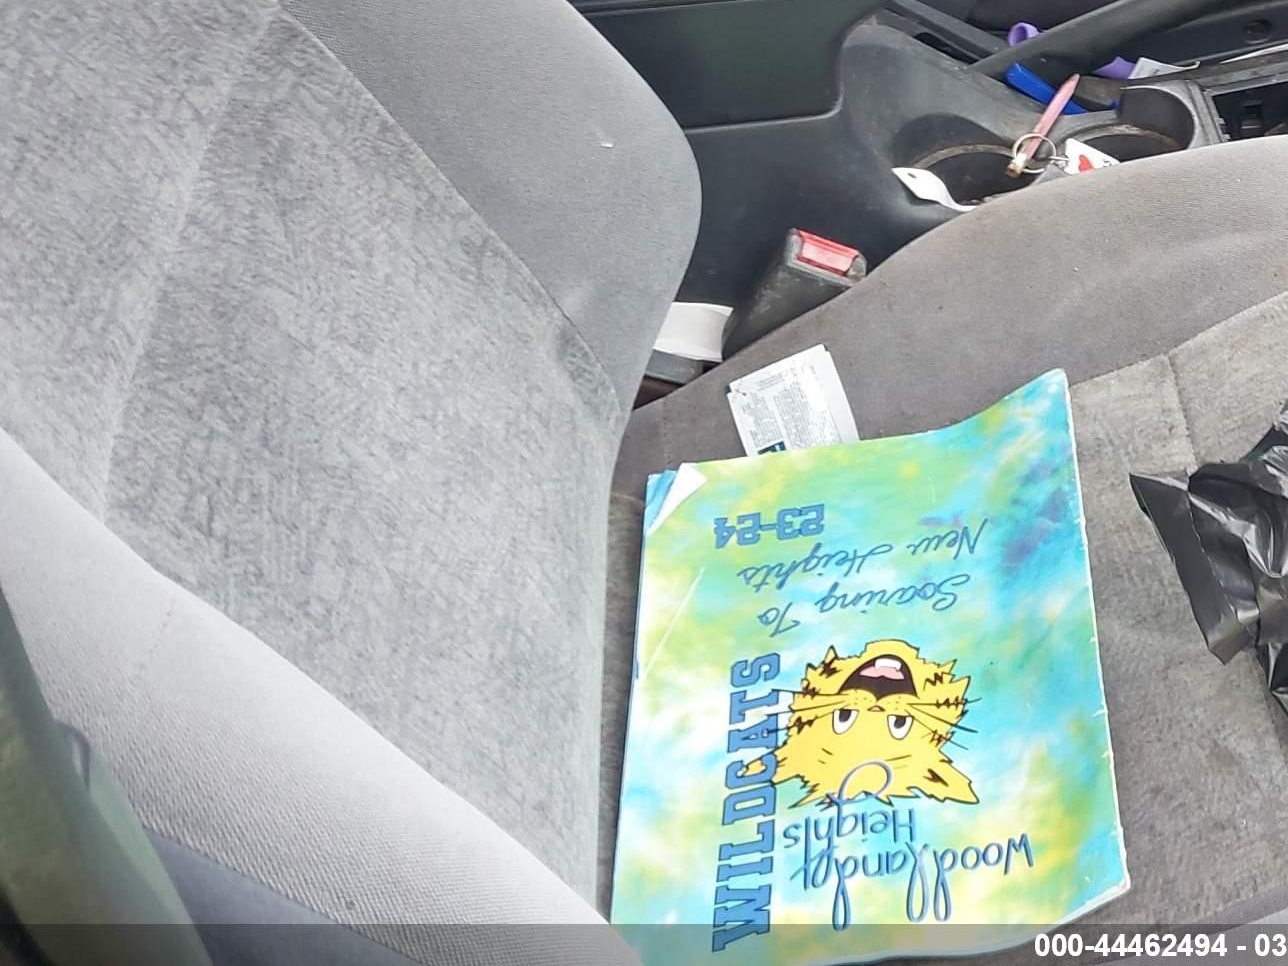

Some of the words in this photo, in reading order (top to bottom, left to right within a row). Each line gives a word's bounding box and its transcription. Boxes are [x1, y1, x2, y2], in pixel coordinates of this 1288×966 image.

[714, 503, 826, 549] 23-24
[908, 519, 988, 560] New
[737, 542, 893, 592] Heights
[814, 573, 970, 614] Soaring
[757, 600, 799, 637] To
[712, 652, 781, 952] WILDCATS
[782, 762, 915, 892] Heights
[830, 831, 1034, 932] Woodland
